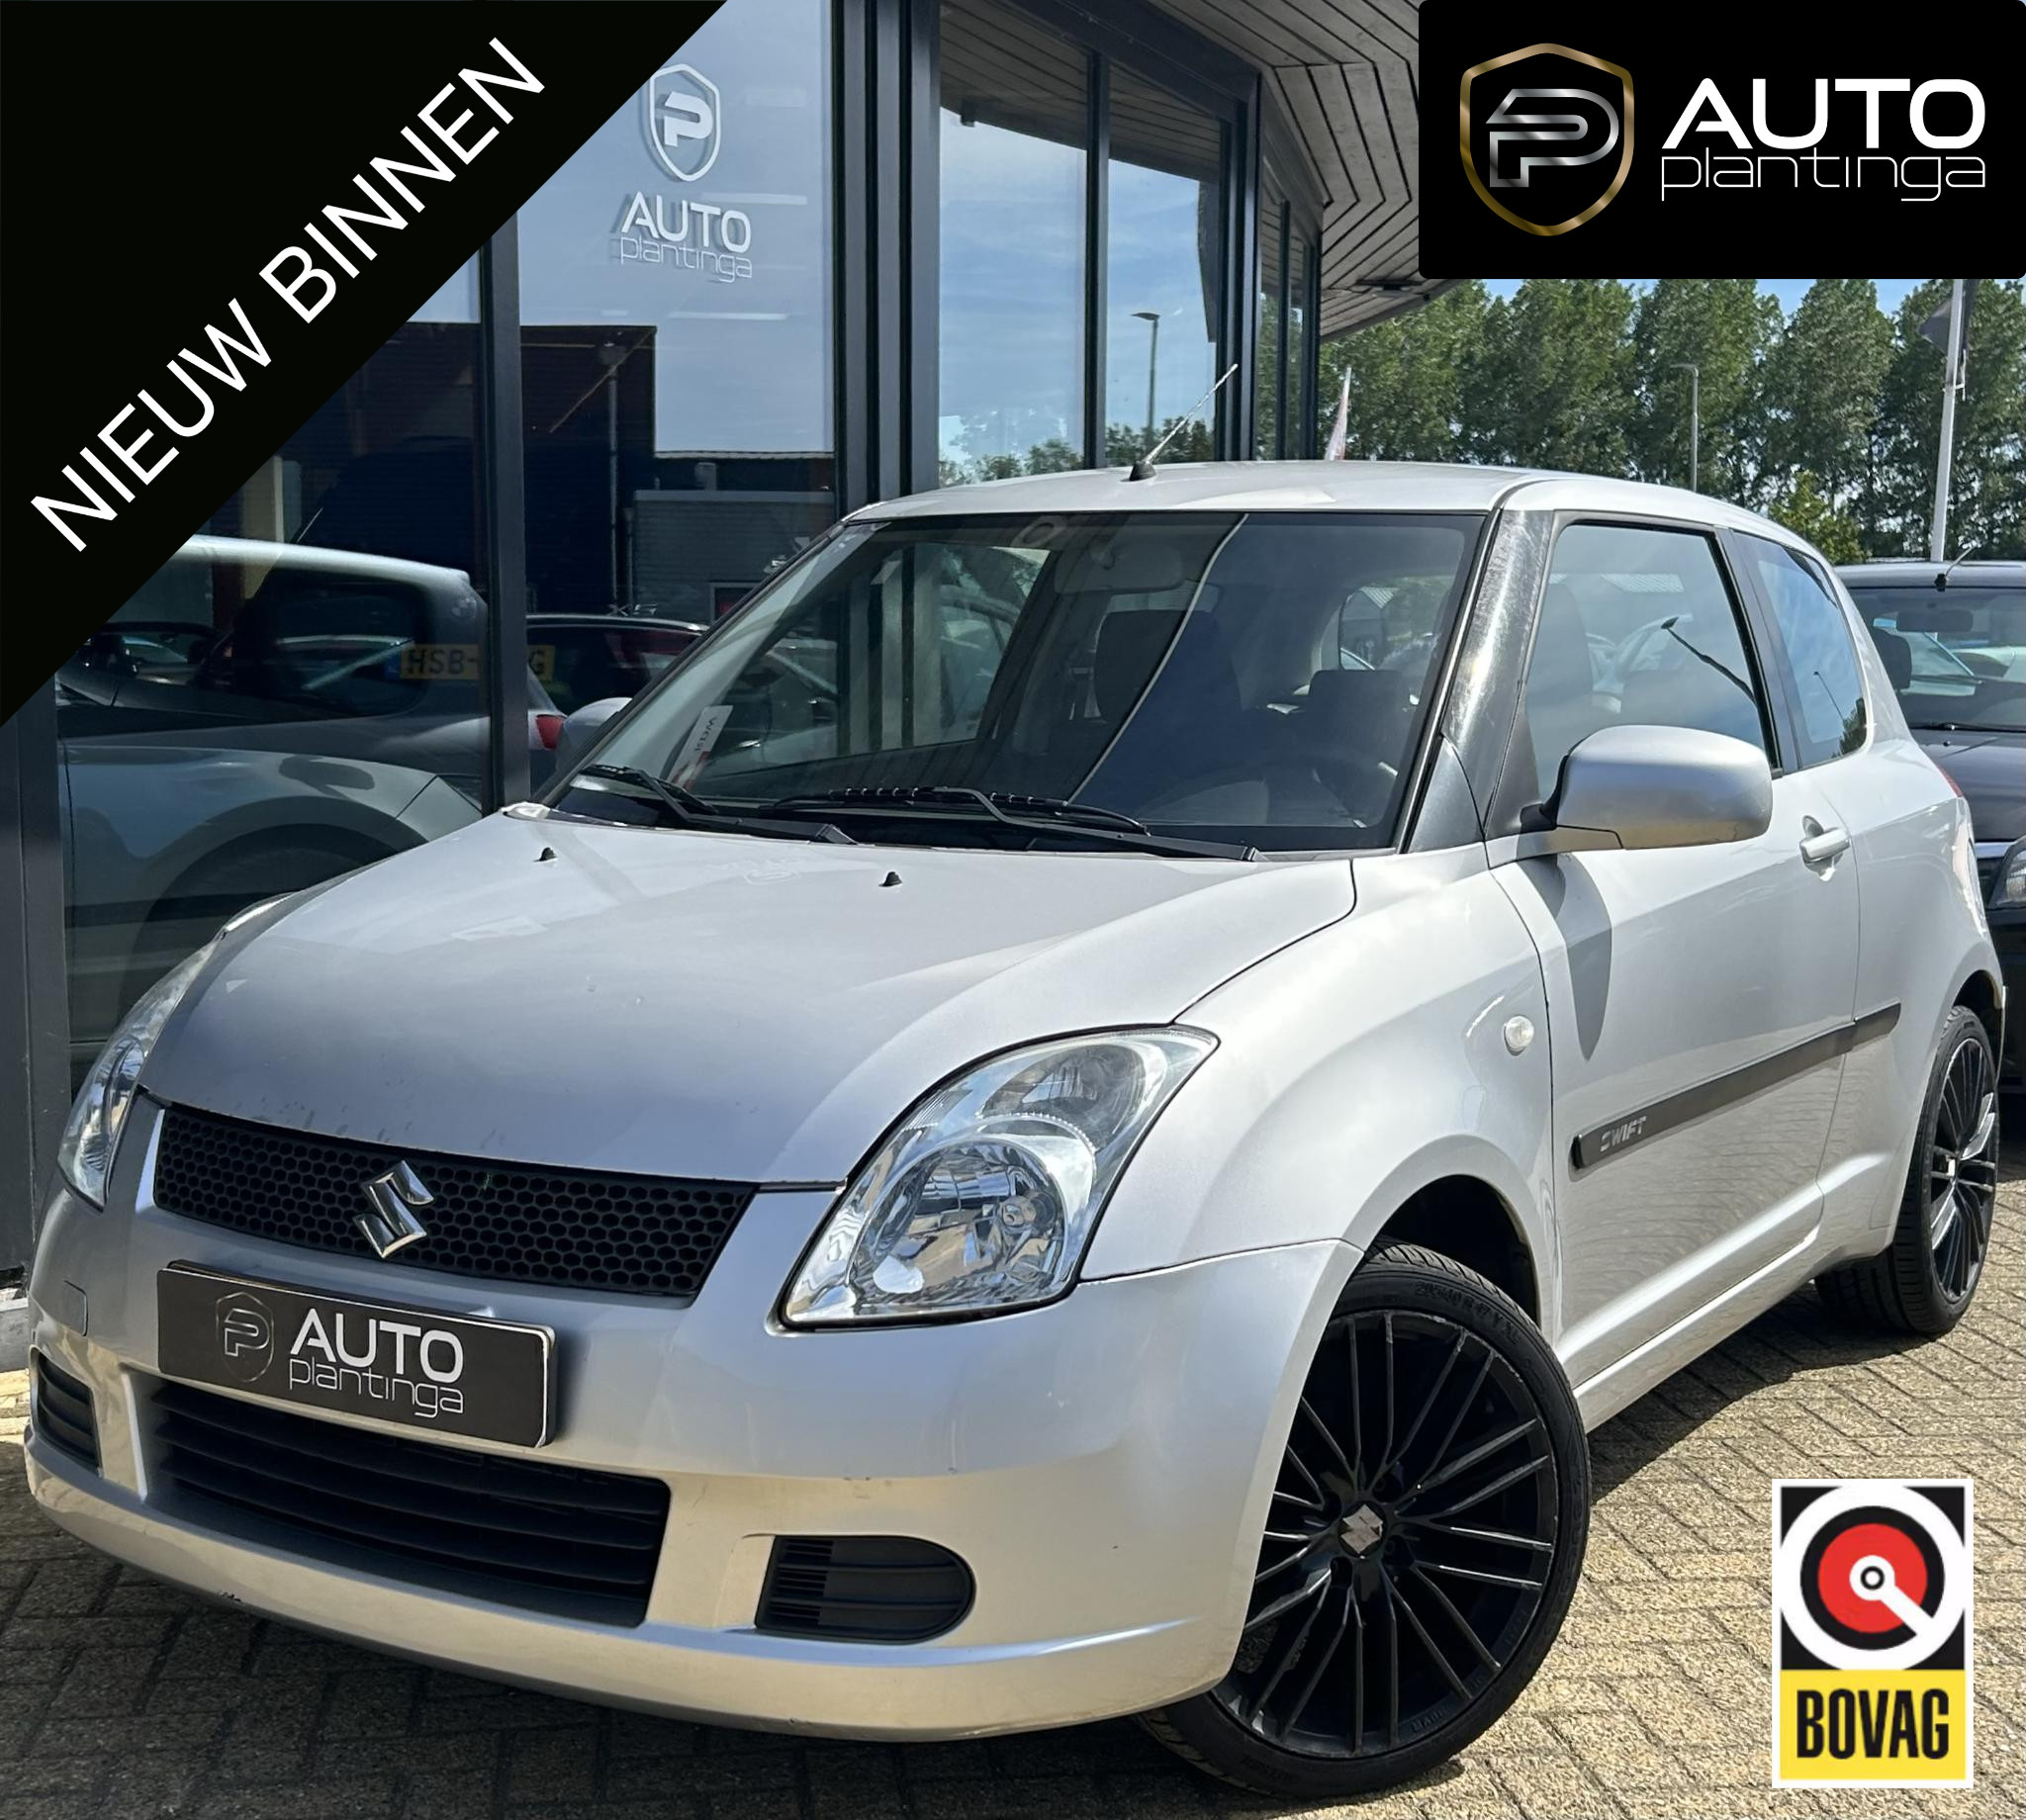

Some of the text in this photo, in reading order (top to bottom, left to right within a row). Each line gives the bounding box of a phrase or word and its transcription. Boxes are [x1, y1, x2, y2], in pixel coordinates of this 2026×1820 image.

[621, 191, 752, 253] AUTO
[620, 234, 753, 283] plantinga
[1600, 1116, 1647, 1152] SWIFT
[290, 1309, 464, 1384] AUTO
[289, 1357, 465, 1418] plantinga
